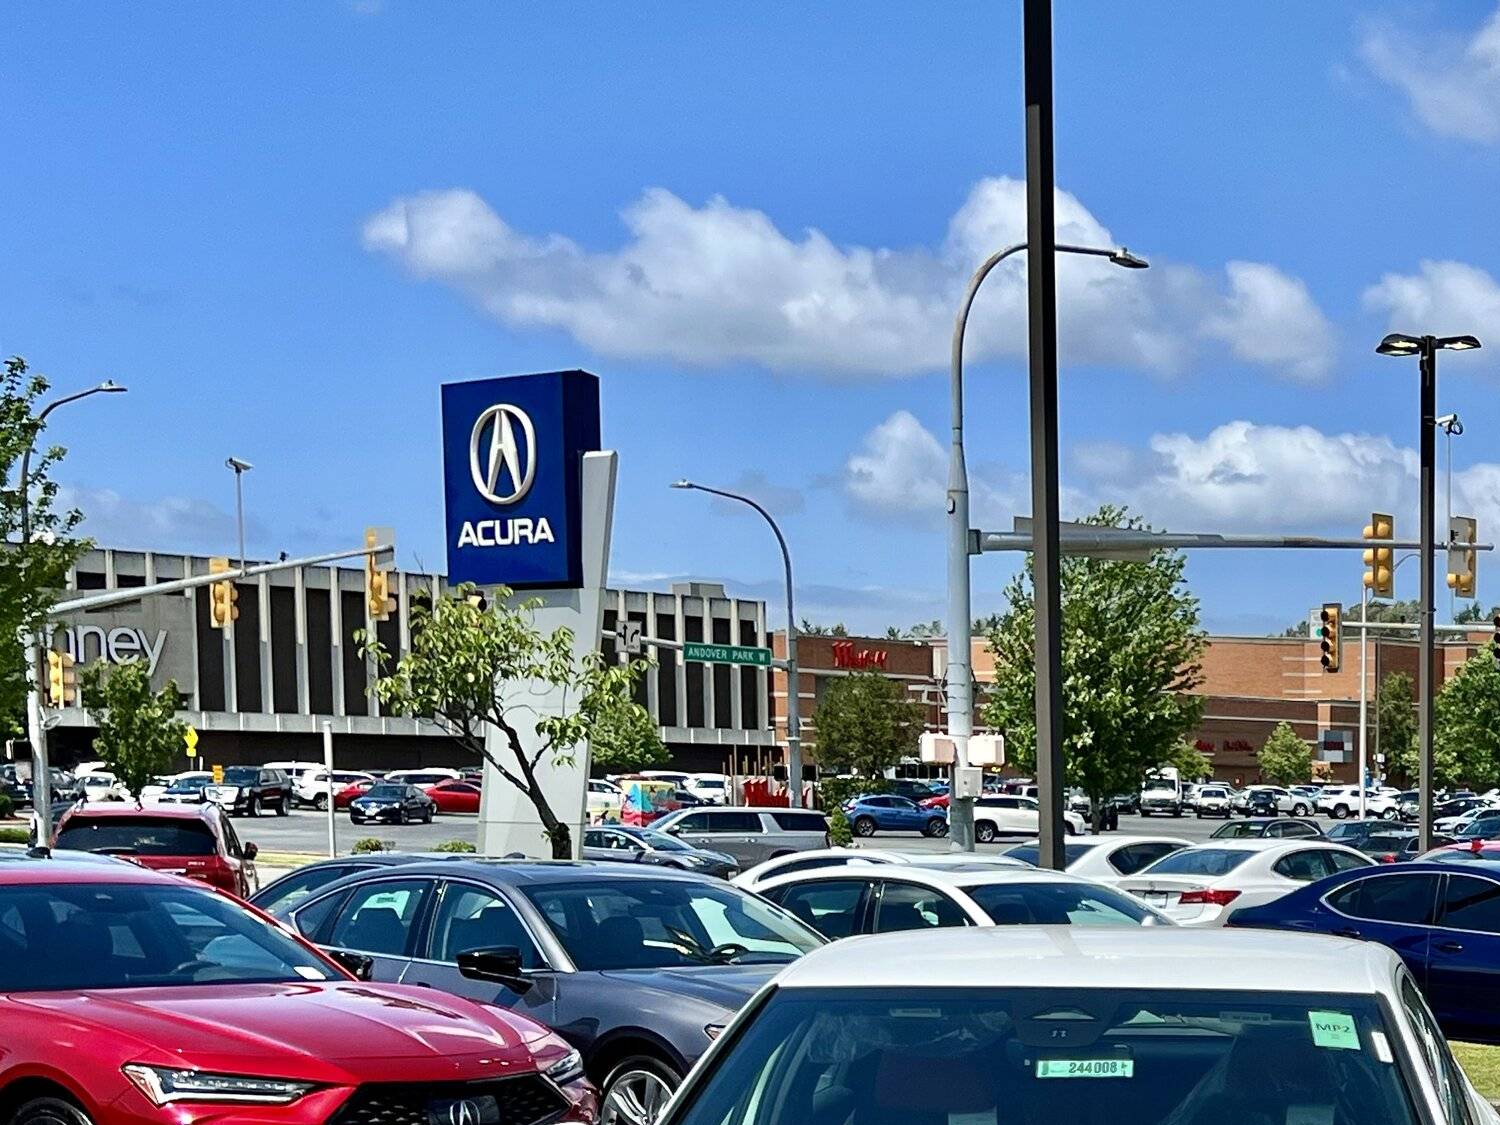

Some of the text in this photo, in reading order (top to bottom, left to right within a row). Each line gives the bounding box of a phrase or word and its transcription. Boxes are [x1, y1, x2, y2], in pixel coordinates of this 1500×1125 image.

[457, 517, 555, 549] ACURA
[687, 647, 766, 662] ANDOVER PARK W
[1315, 1022, 1351, 1034] MP2
[1068, 1061, 1118, 1074] 244008
